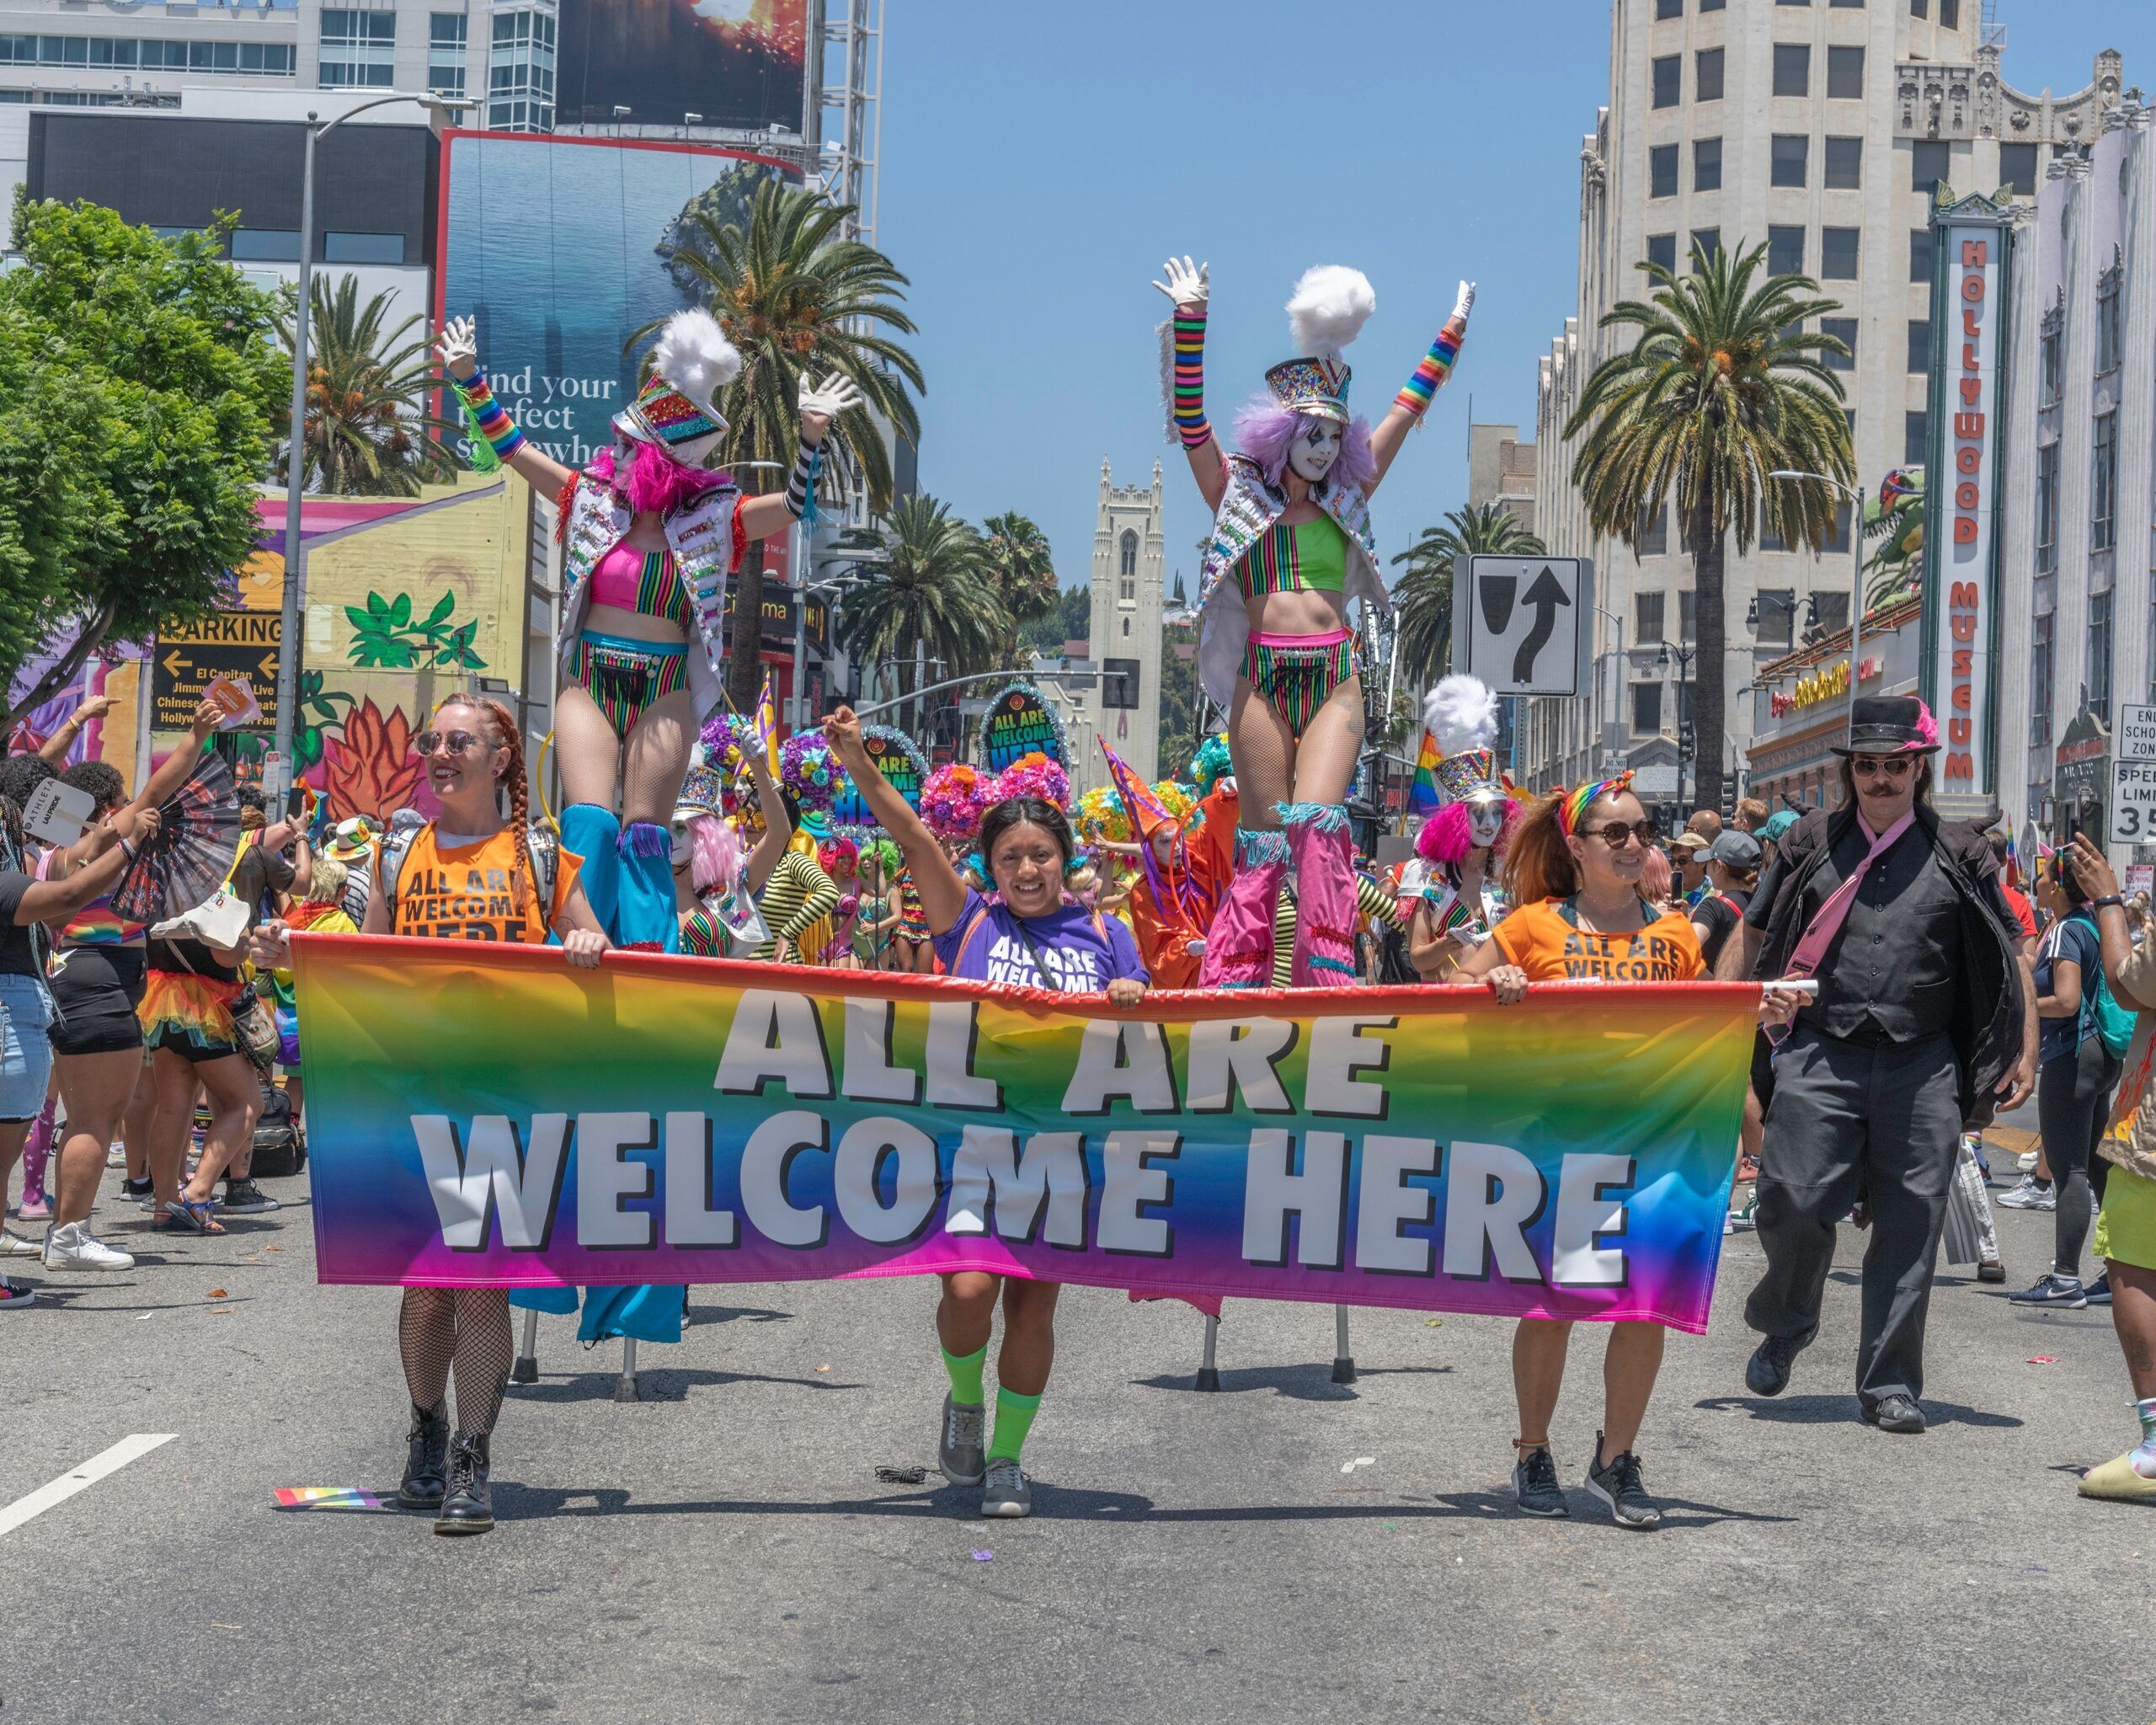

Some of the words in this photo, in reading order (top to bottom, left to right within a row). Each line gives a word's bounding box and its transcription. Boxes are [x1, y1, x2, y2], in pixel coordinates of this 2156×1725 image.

[475, 365, 531, 394] ind
[540, 375, 617, 404] your
[1953, 239, 1987, 544] HOLLYWOOD
[456, 397, 574, 430] pfect
[167, 614, 282, 643] PARKING
[196, 668, 207, 679] El
[1944, 581, 1978, 780] MUSEUM
[157, 697, 199, 708] Chinese
[253, 685, 275, 696] Live
[257, 717, 276, 725] Fam
[995, 714, 1016, 731] ALL
[1020, 709, 1045, 726] ARE
[2125, 726, 2156, 739] SCHO
[990, 724, 1054, 748] WELCOME
[2132, 743, 2155, 755] ZON
[878, 756, 910, 772] ARE
[29, 780, 55, 823] ATHLETA
[2123, 788, 2156, 802] LIMI
[405, 868, 452, 898] ALL
[989, 935, 1035, 967] ALL
[1043, 946, 1098, 975] ARE
[1564, 932, 1614, 958] ALL
[1628, 934, 1679, 968] ARE
[1564, 959, 1678, 981] WELCOME
[714, 989, 1003, 1113] ALL
[1061, 1016, 1400, 1119] ARE
[410, 1111, 1182, 1258] WELCOME
[1241, 1129, 1636, 1287] HERE
